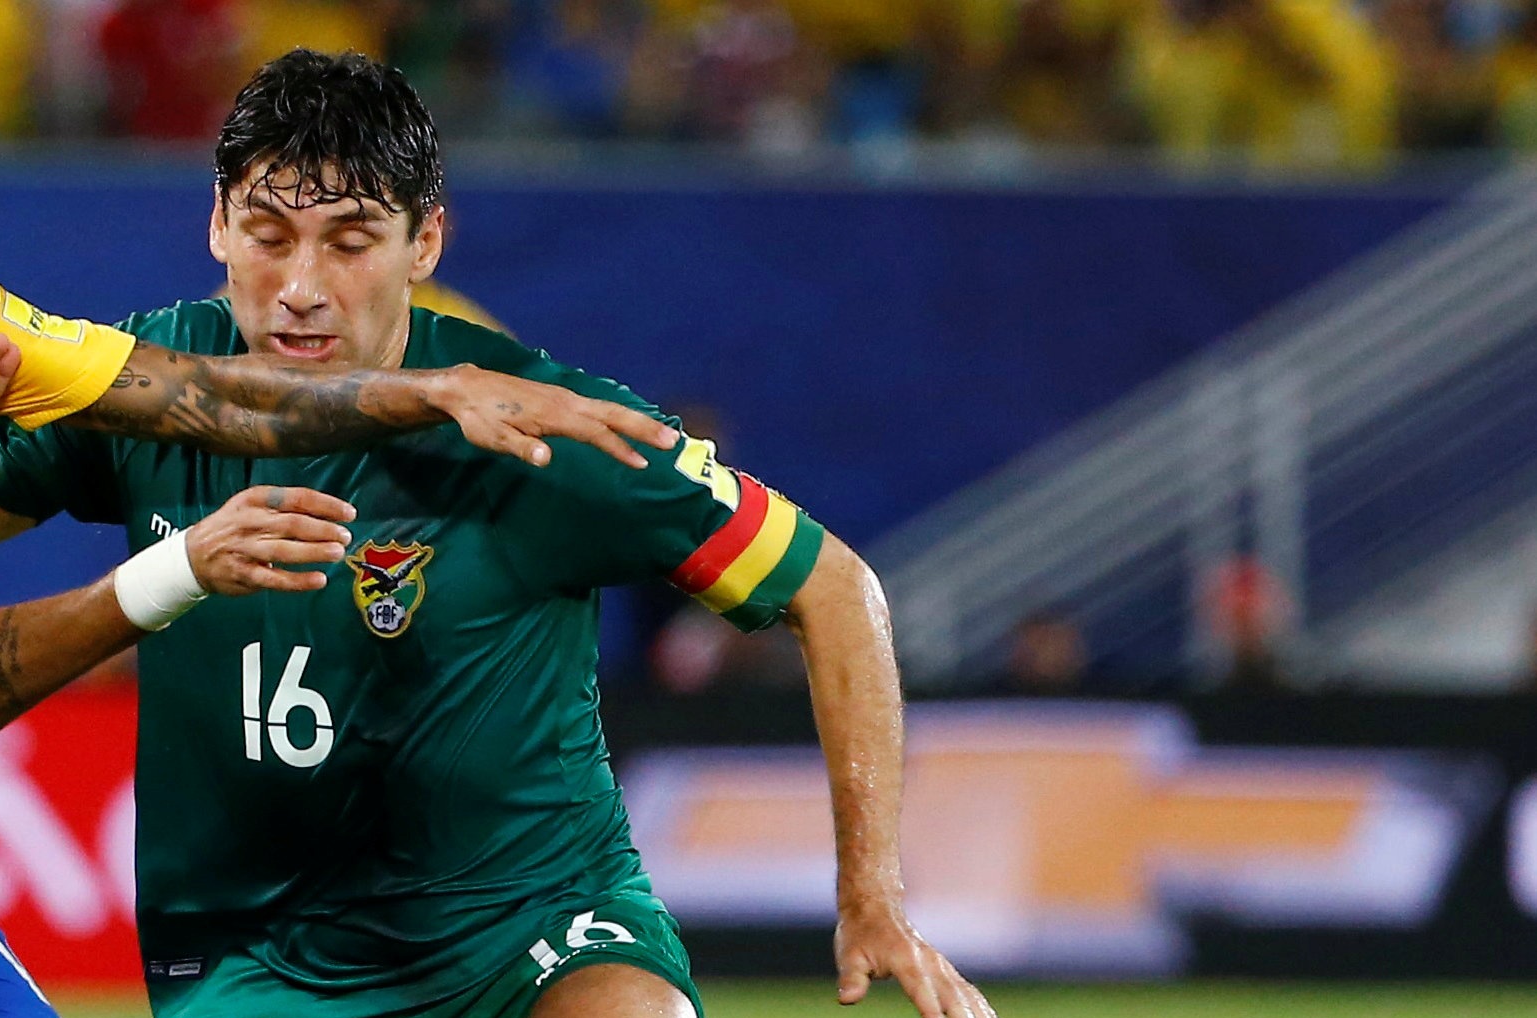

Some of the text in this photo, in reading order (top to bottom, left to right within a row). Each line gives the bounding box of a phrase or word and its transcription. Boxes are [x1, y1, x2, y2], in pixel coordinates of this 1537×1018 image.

[150, 512, 179, 540] m
[375, 604, 399, 625] FBF
[242, 641, 335, 768] 16
